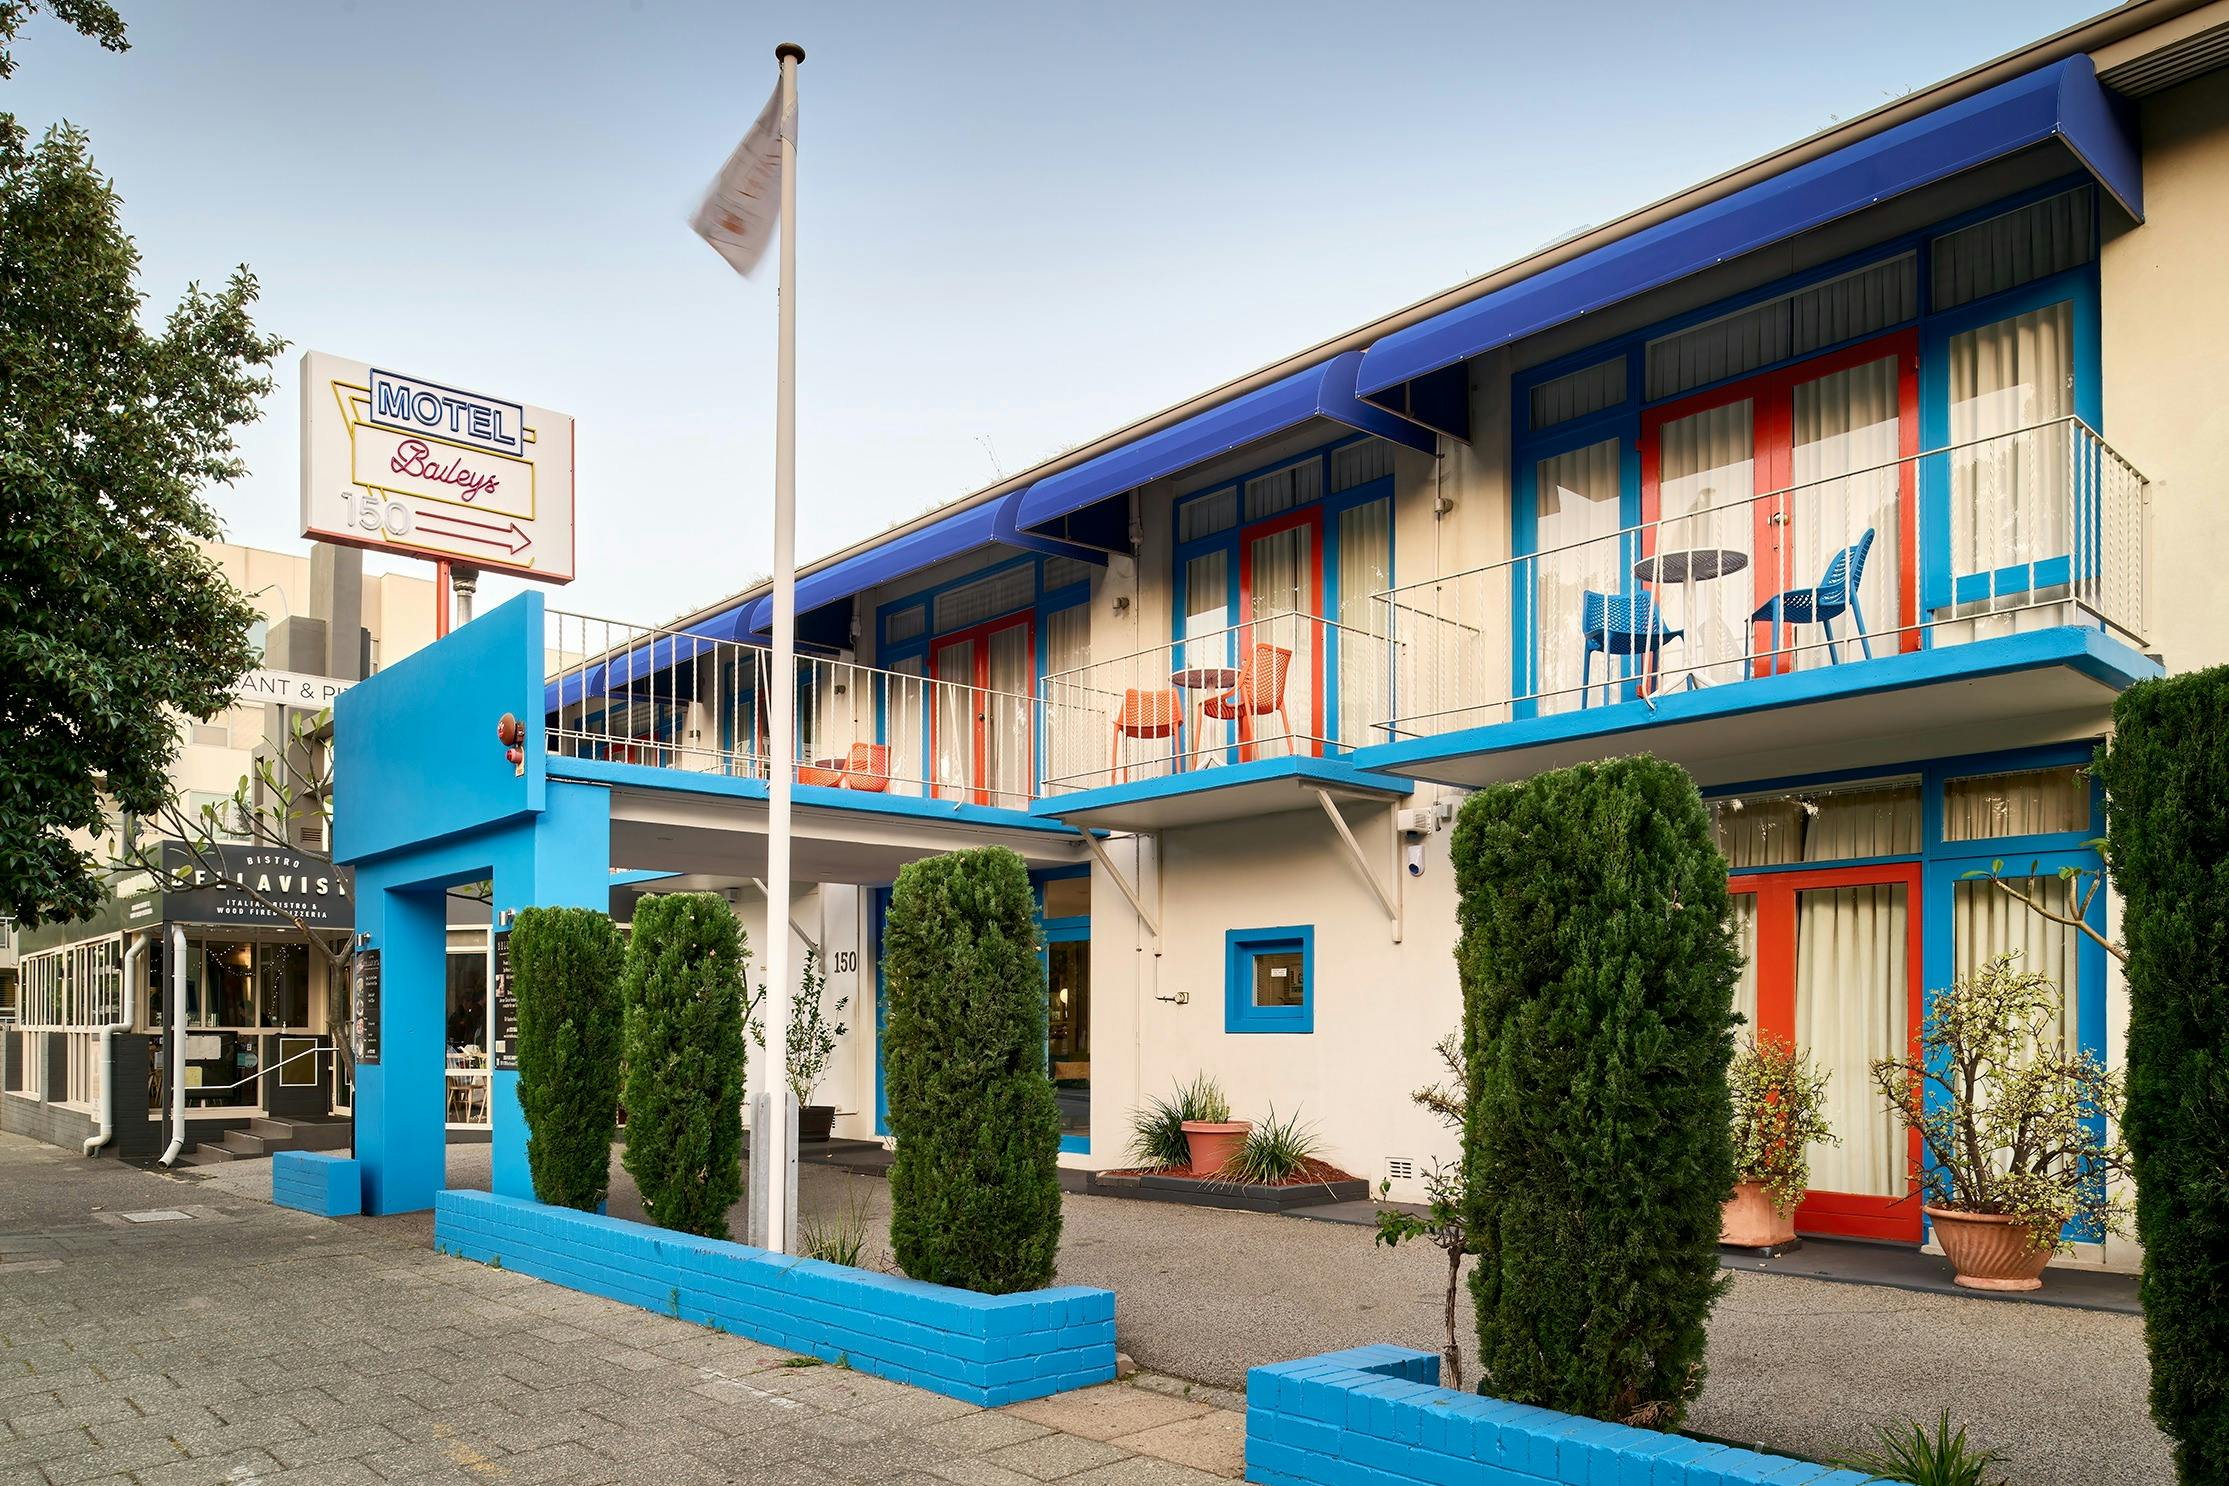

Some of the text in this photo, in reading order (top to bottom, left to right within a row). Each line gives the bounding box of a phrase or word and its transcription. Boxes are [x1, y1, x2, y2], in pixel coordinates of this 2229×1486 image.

[376, 379, 516, 446] MOTEL
[390, 438, 500, 502] Baileys
[340, 491, 411, 536] 150
[234, 674, 290, 695] ANT
[300, 682, 315, 699] &
[246, 855, 300, 869] BISTRO
[216, 907, 244, 915] WOOD
[283, 910, 328, 919] IZZERIA
[226, 899, 265, 908] ITALIA
[834, 951, 857, 973] 150
